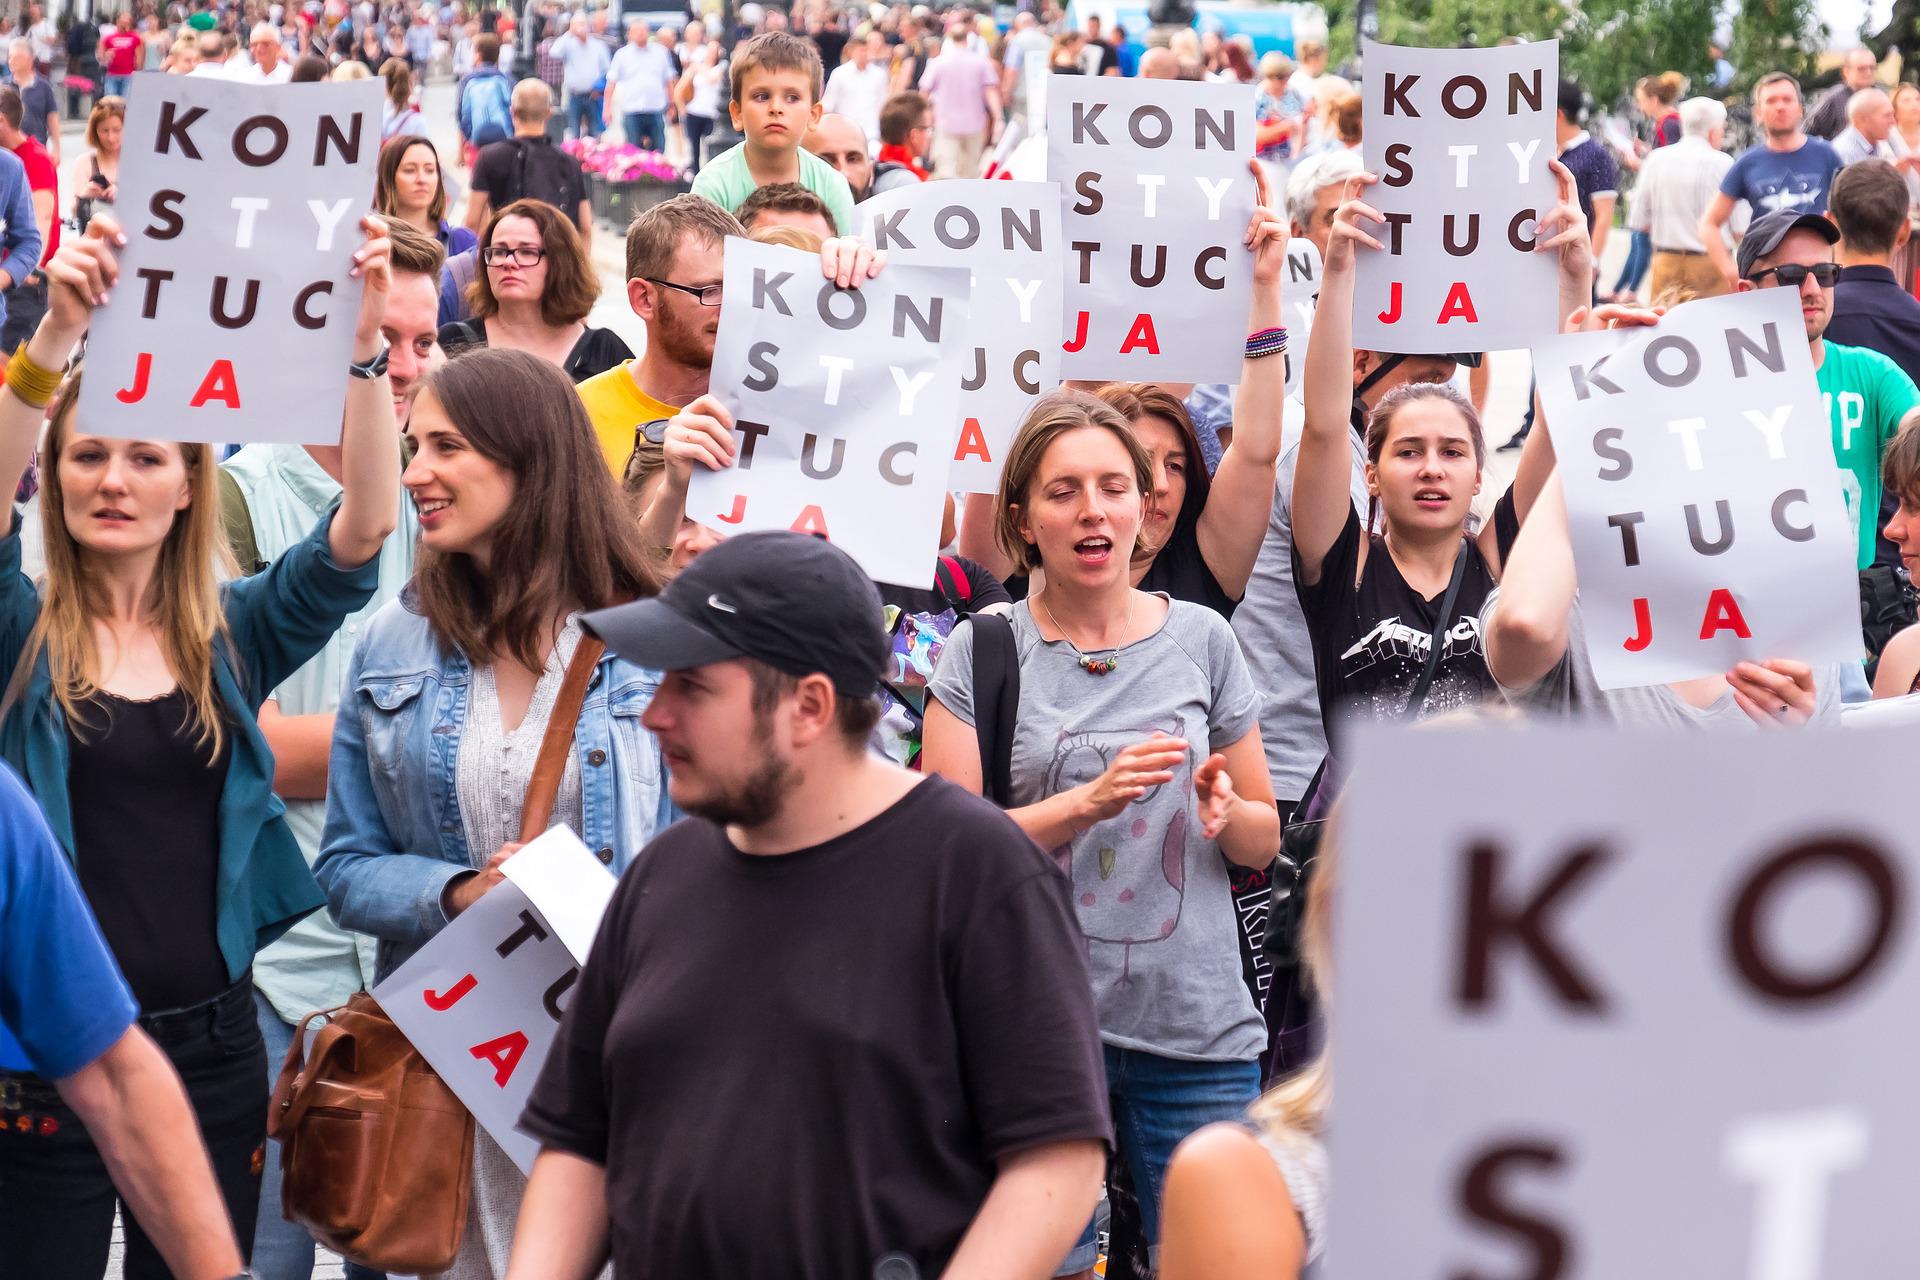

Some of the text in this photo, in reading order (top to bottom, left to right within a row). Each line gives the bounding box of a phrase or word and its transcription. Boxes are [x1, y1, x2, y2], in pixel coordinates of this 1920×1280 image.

[1383, 69, 1542, 119] KON
[153, 101, 363, 167] KON
[1072, 102, 1235, 151] KON
[1382, 139, 1542, 188] STY
[142, 189, 354, 251] STY
[1073, 171, 1234, 220] STY
[874, 205, 1043, 252] KON
[1383, 209, 1536, 257] TUC
[1072, 241, 1227, 290] TUC
[136, 267, 334, 330] TUC
[752, 268, 944, 343] KON
[1377, 282, 1479, 324] JA
[1062, 311, 1161, 355] JA
[1569, 322, 1787, 401] KON
[115, 352, 241, 409] JA
[742, 341, 936, 416] STY
[735, 419, 919, 486] TUC
[953, 417, 992, 462] A
[1592, 405, 1794, 481] STY
[716, 494, 830, 541] JA
[1608, 488, 1817, 567] TUC
[1623, 588, 1753, 652] JA
[1452, 829, 1905, 1017] KO
[423, 973, 530, 1089] JA
[1443, 1110, 1868, 1280] ST
